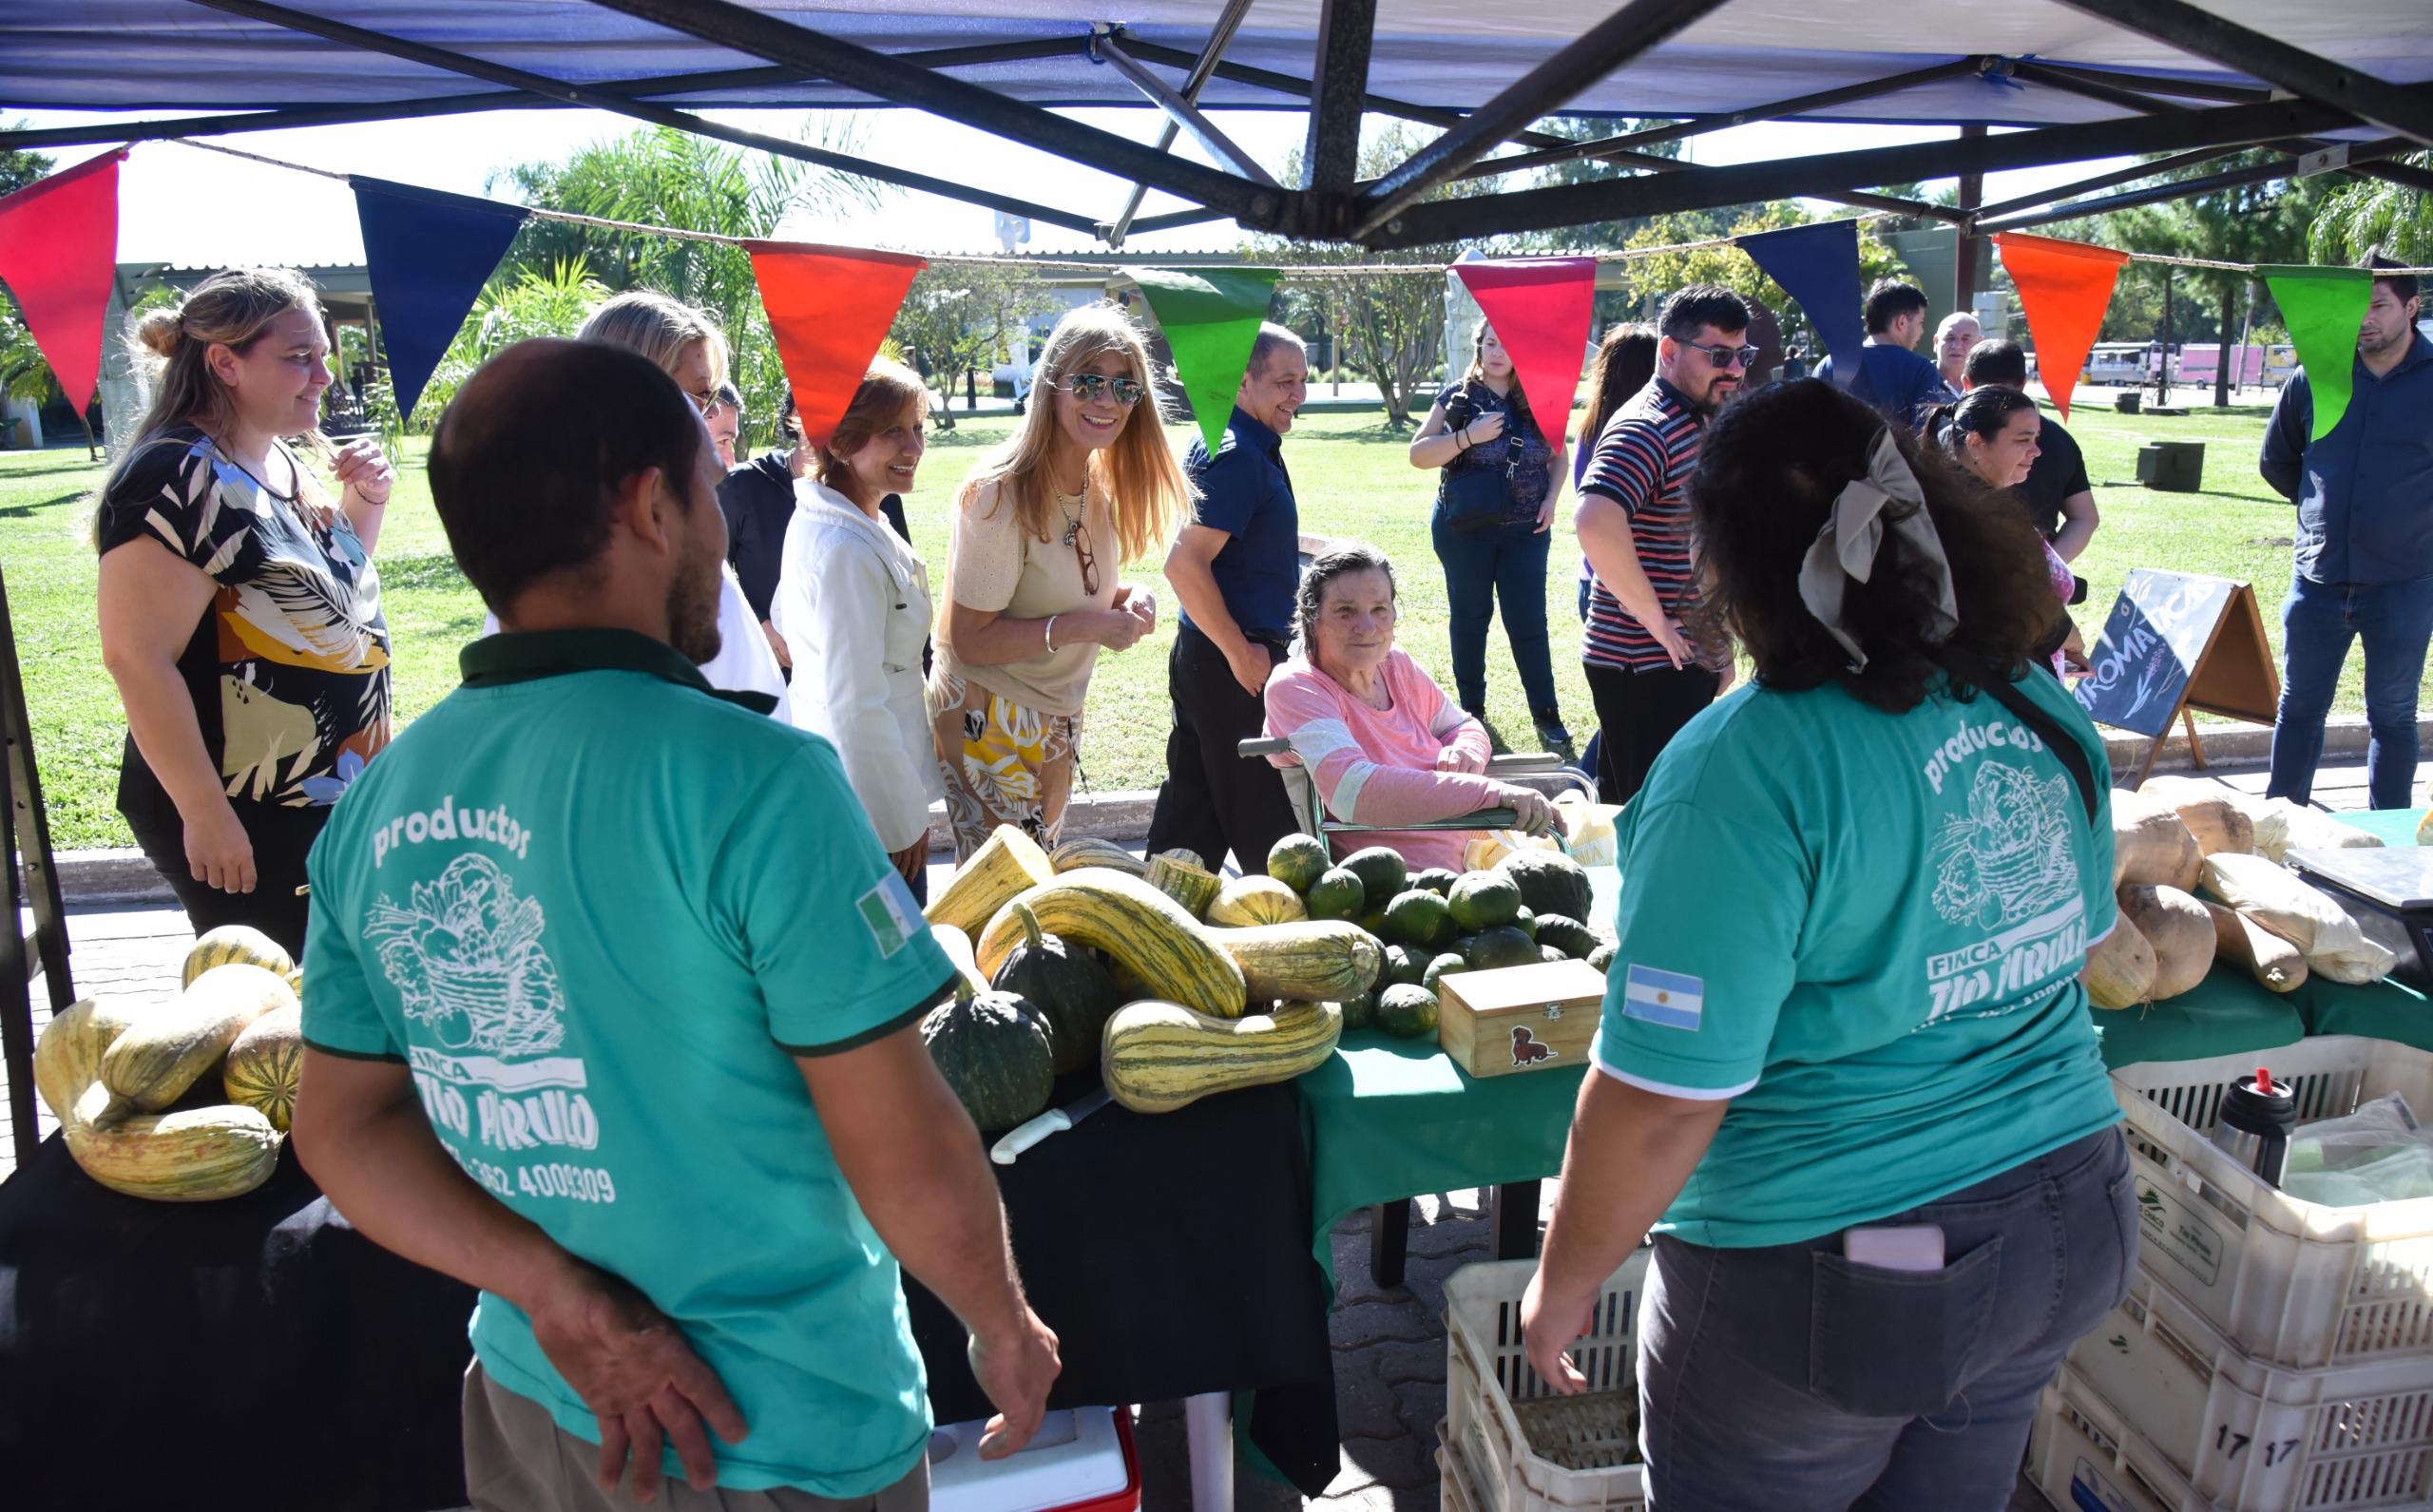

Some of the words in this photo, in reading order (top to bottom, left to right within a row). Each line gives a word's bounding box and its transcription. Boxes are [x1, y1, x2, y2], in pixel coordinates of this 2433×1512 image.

[1924, 719, 2043, 795] producos
[374, 794, 531, 870] productos
[1931, 941, 2002, 977] FINCA
[2216, 1424, 2251, 1461] 17
[2266, 1440, 2300, 1467] 17
